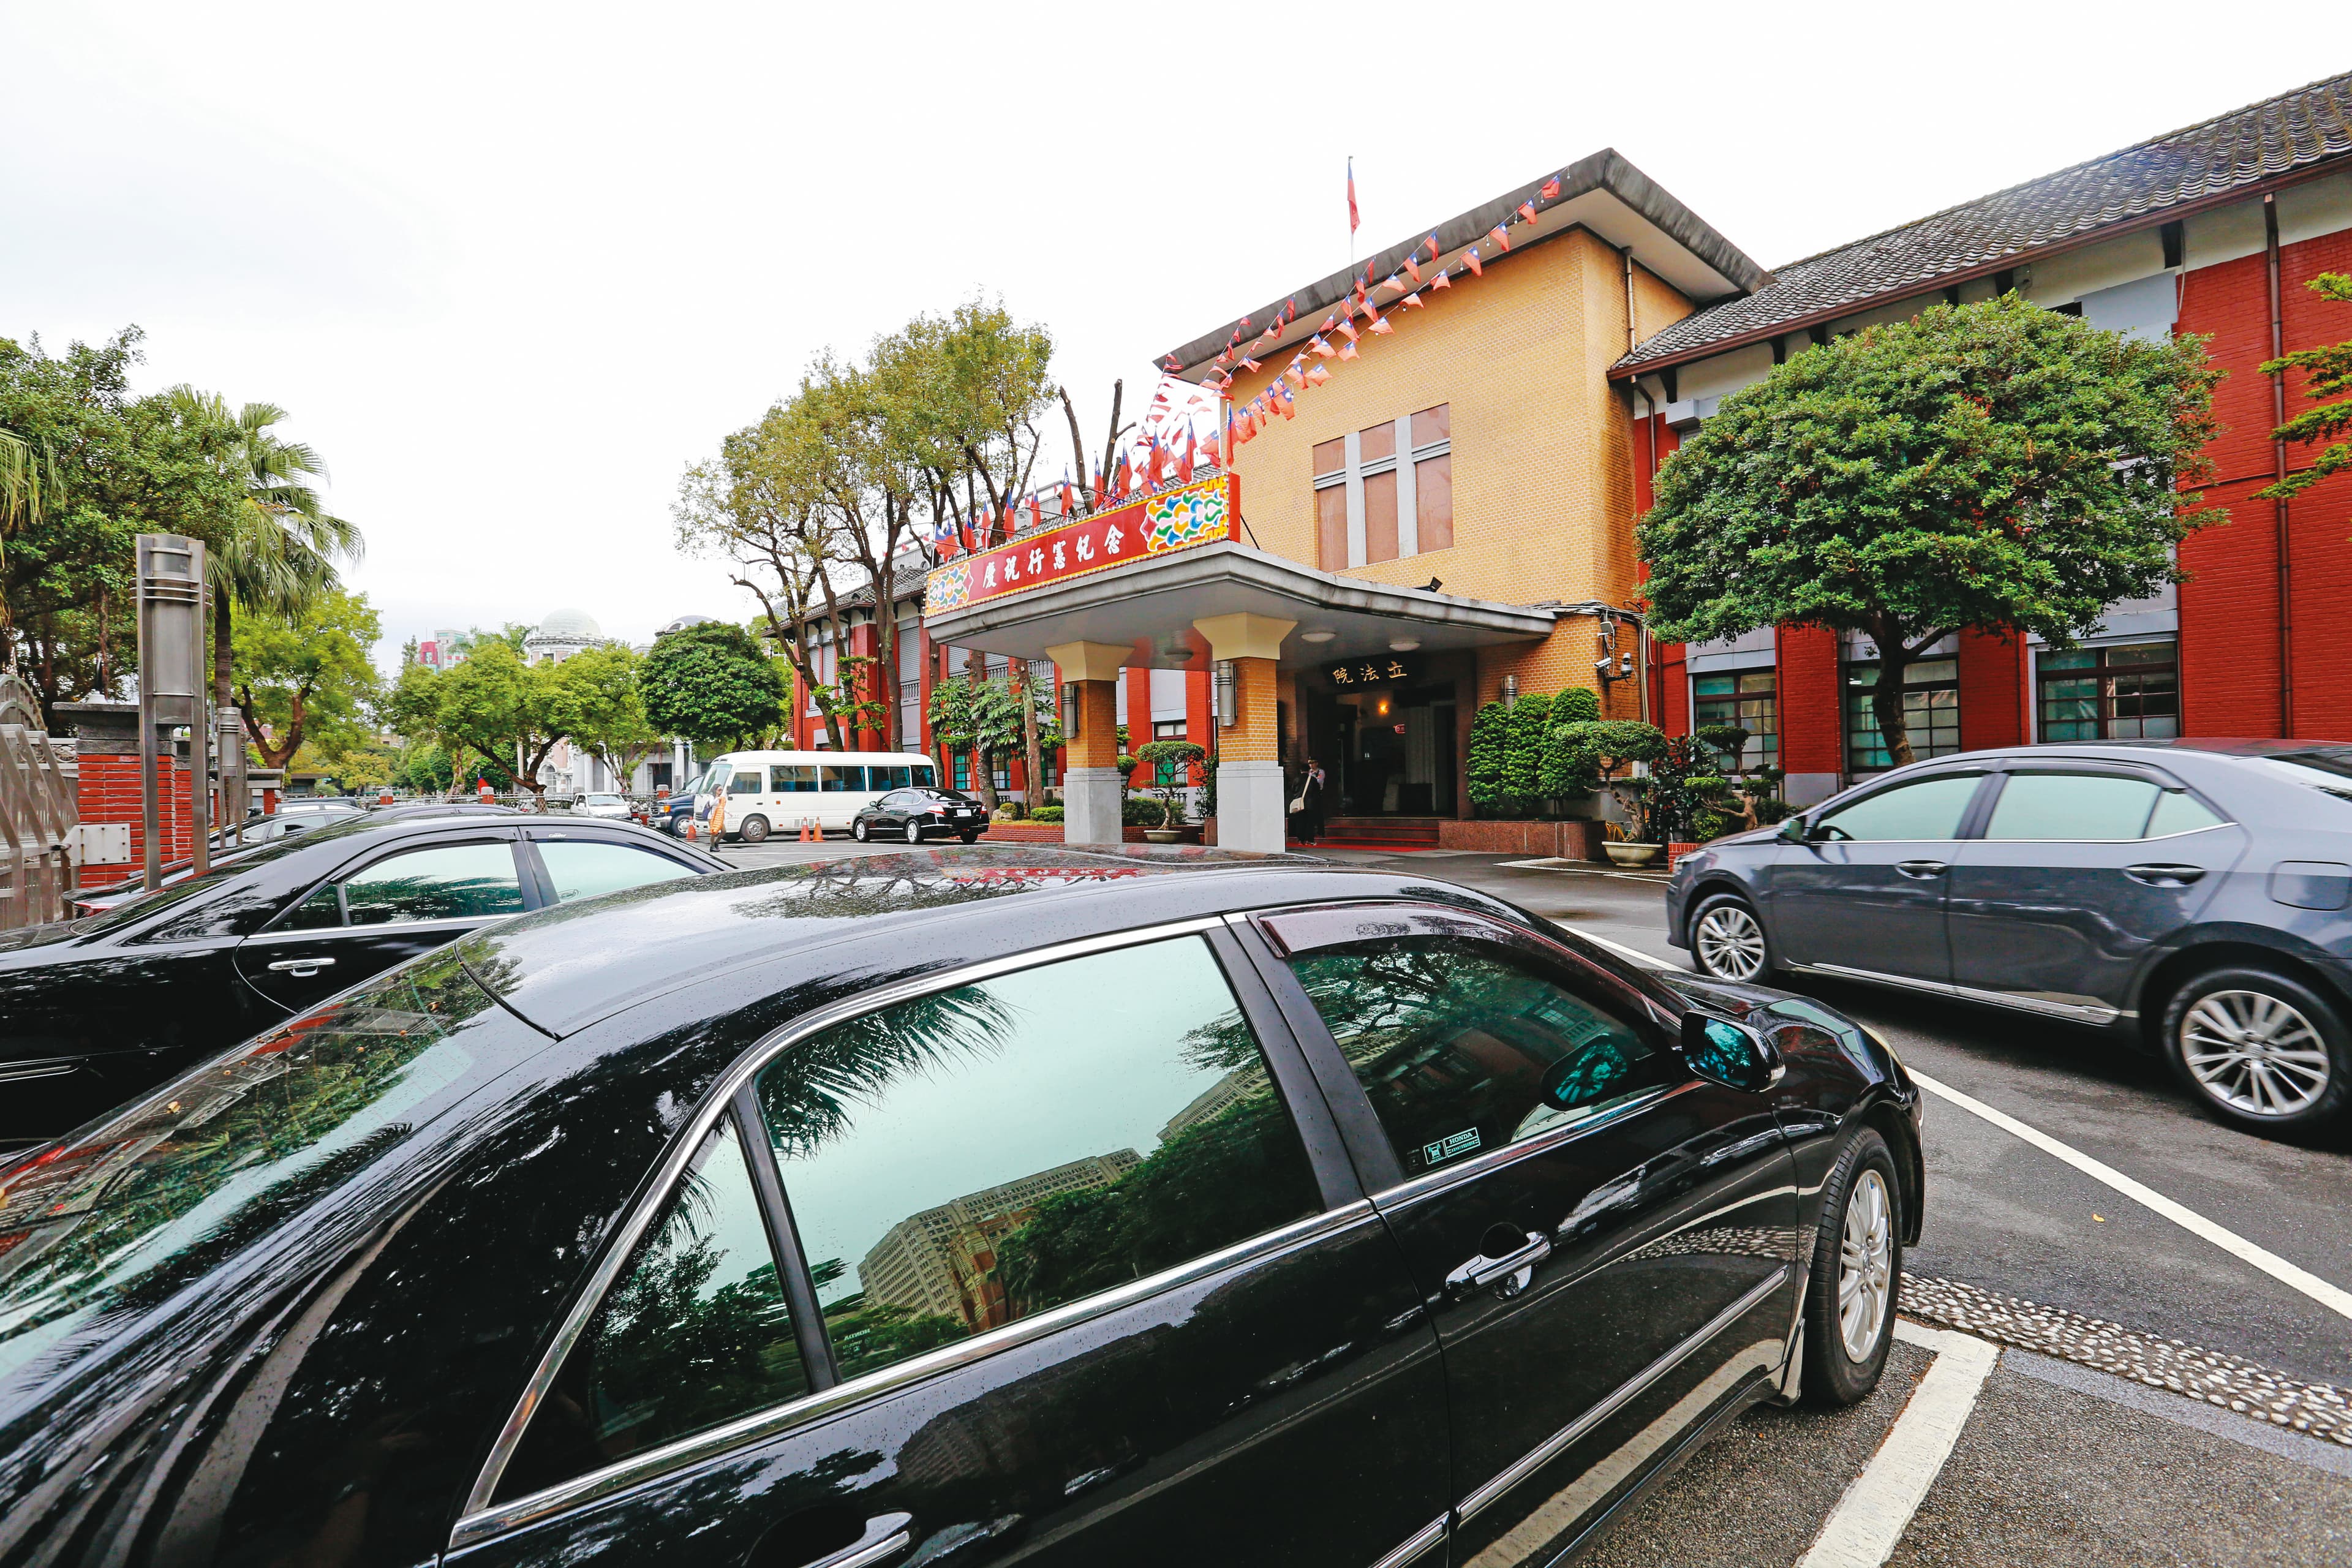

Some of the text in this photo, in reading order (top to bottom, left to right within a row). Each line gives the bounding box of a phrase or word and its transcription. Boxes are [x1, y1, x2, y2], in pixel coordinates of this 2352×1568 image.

[982, 524, 1125, 589] 慶祝行憲紀念
[1449, 1132, 1473, 1145] HONDA
